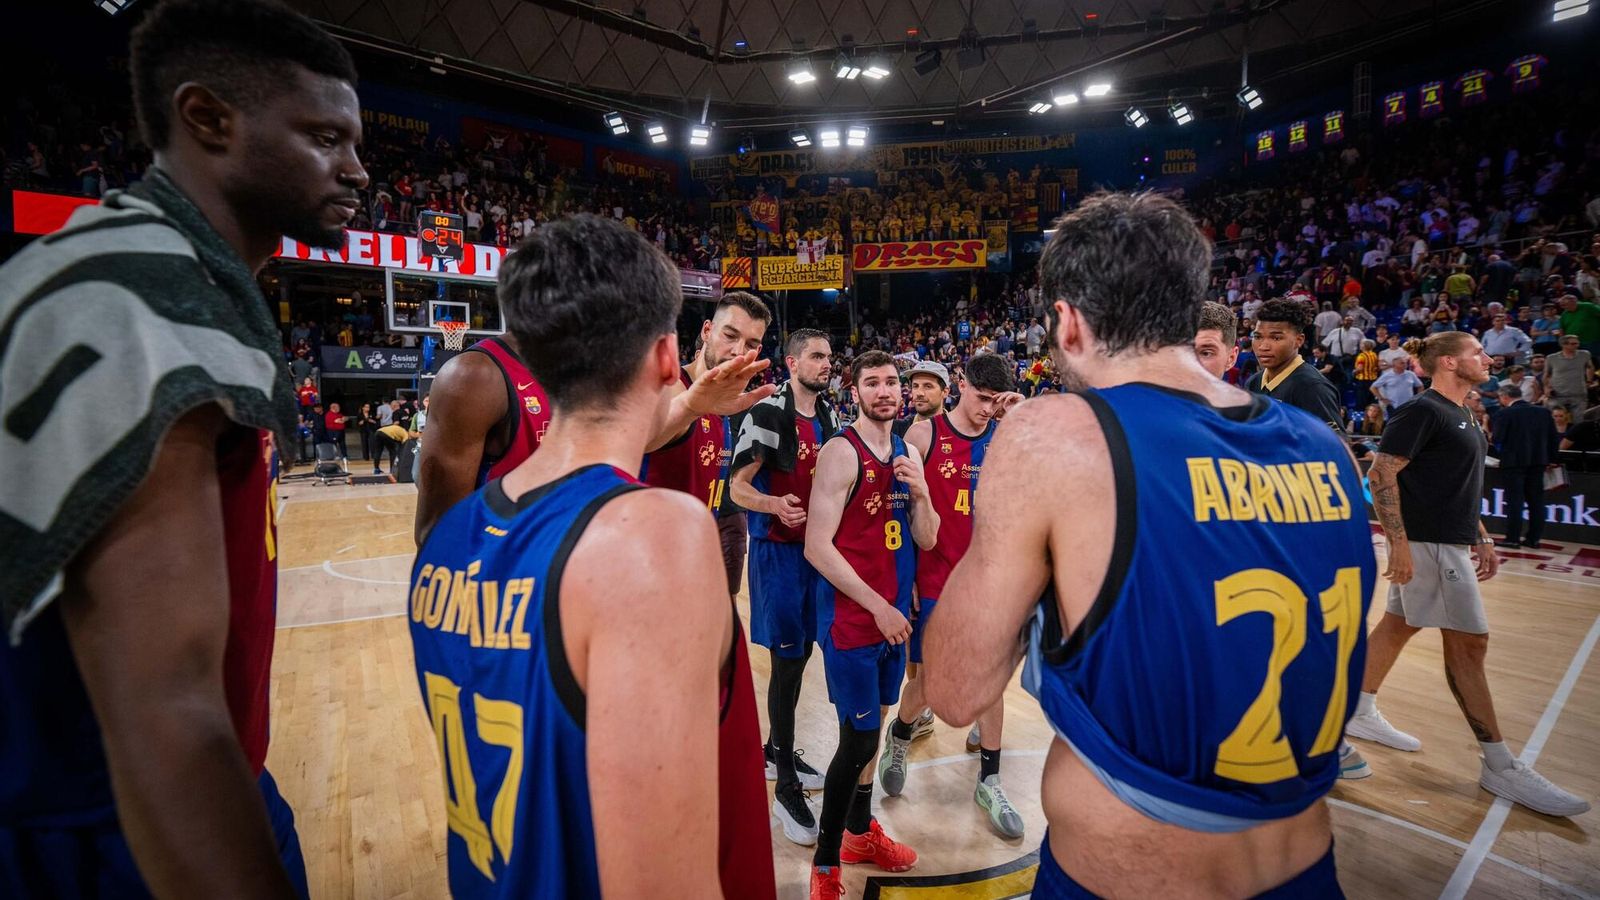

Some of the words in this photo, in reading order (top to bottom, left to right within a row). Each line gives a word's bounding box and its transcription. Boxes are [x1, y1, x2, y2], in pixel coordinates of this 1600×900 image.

[1519, 64, 1532, 78] 9
[1462, 77, 1483, 93] 21
[1425, 89, 1437, 103] 4
[1388, 101, 1399, 113] 7
[1326, 117, 1340, 132] 11
[1257, 137, 1273, 149] 15
[1290, 128, 1305, 142] 12
[1164, 148, 1197, 161] 100%
[1161, 161, 1197, 175] CULER
[438, 229, 461, 246] 24
[854, 241, 984, 269] DRACS
[345, 350, 364, 369] A
[707, 478, 725, 512] 14
[1185, 457, 1352, 524] ABRINES
[954, 489, 976, 516] 4
[884, 520, 903, 551] 8
[1213, 567, 1362, 784] 21
[424, 671, 524, 883] 47
